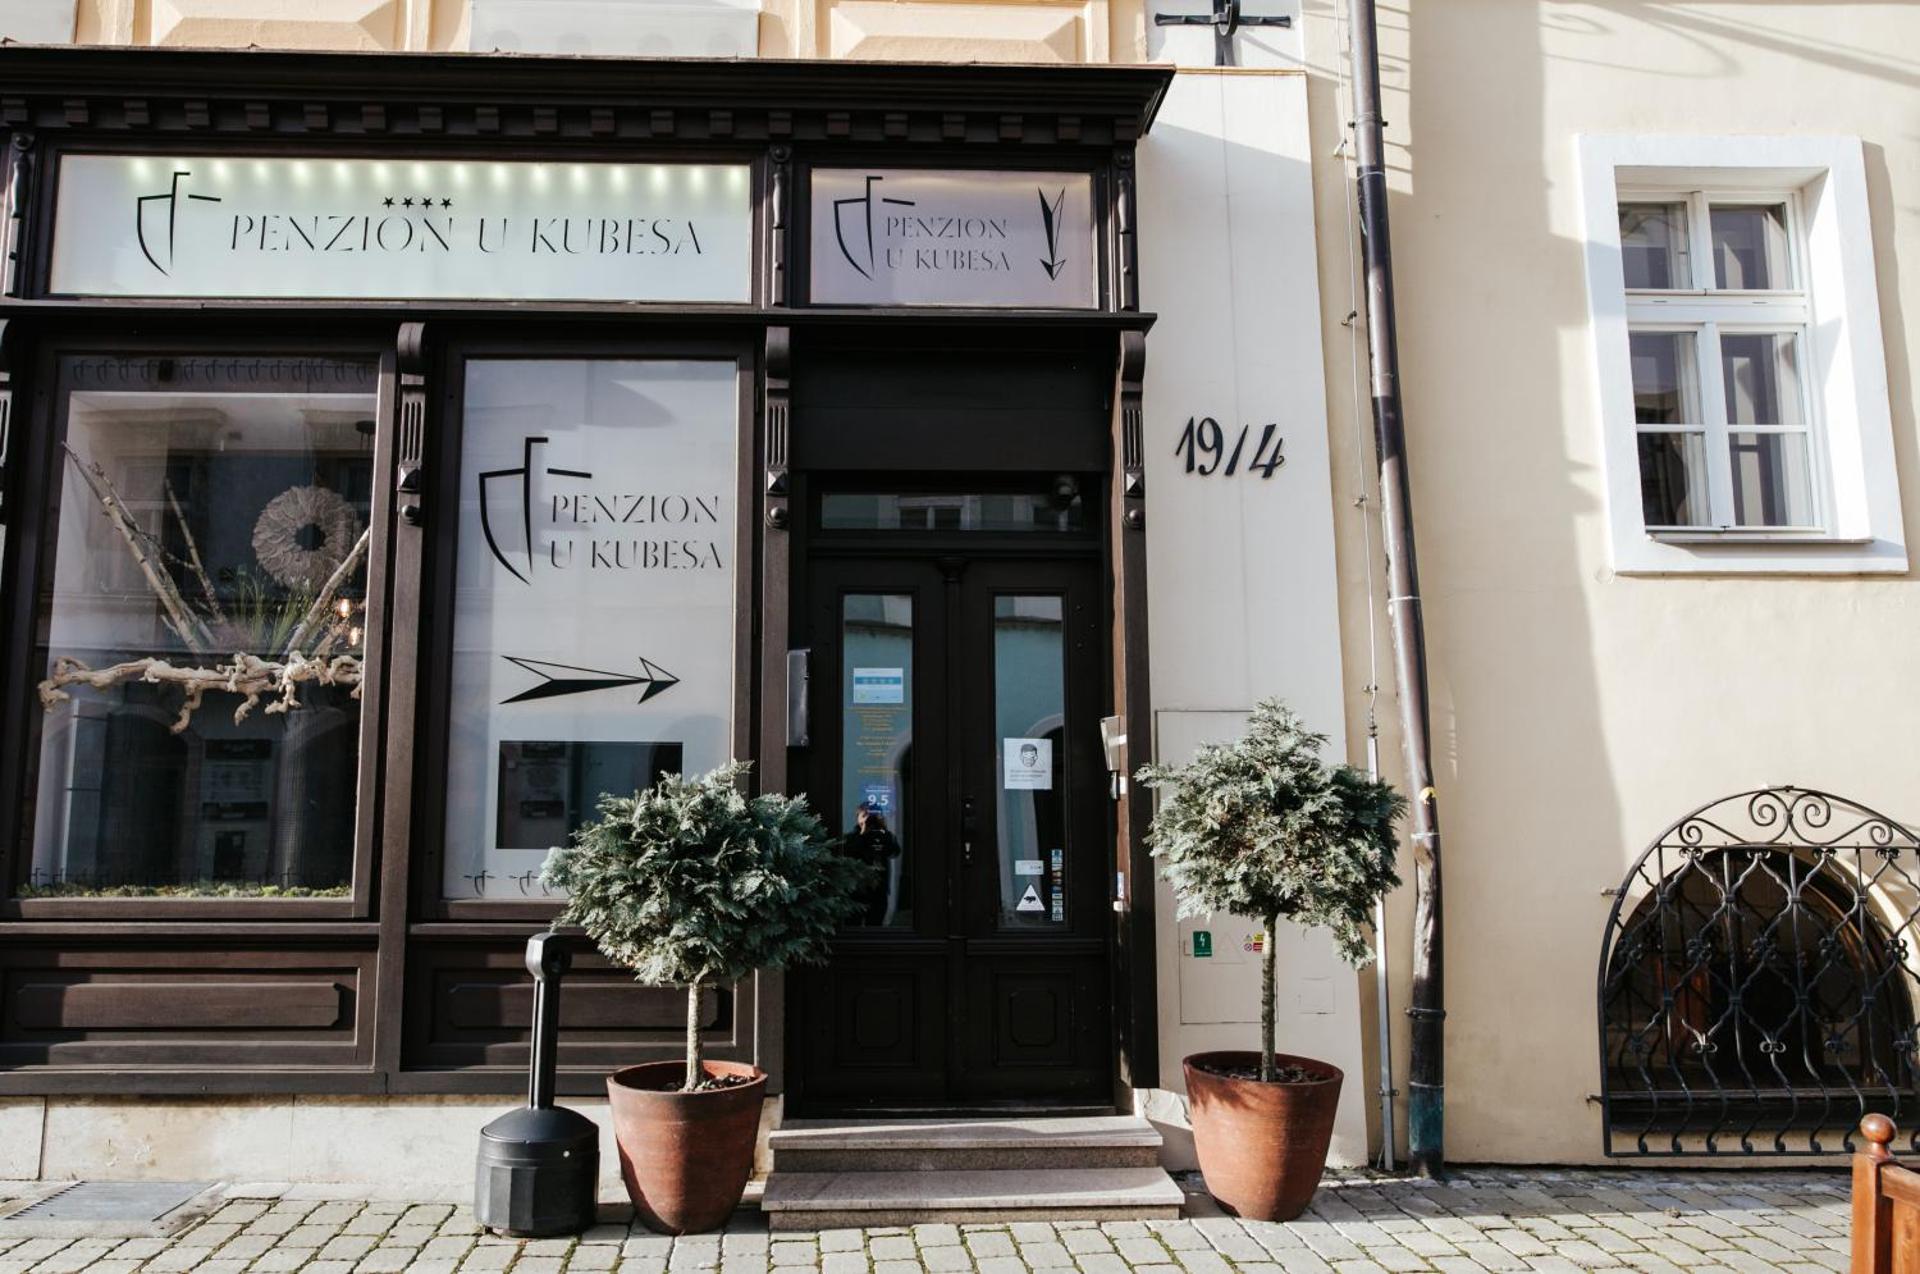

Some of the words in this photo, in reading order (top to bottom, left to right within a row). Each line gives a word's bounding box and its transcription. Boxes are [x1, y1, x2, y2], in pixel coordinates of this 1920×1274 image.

[230, 214, 453, 253] PENZION
[478, 217, 508, 254] U
[530, 217, 703, 255] KUBESA
[886, 216, 1007, 239] PENZION
[886, 247, 903, 269] U
[915, 249, 1010, 272] KUBESA
[1175, 416, 1285, 479] 19/4
[551, 494, 719, 524] PENZION
[550, 540, 573, 570] U
[591, 540, 723, 570] KUBESA
[868, 794, 889, 806] 9.5
